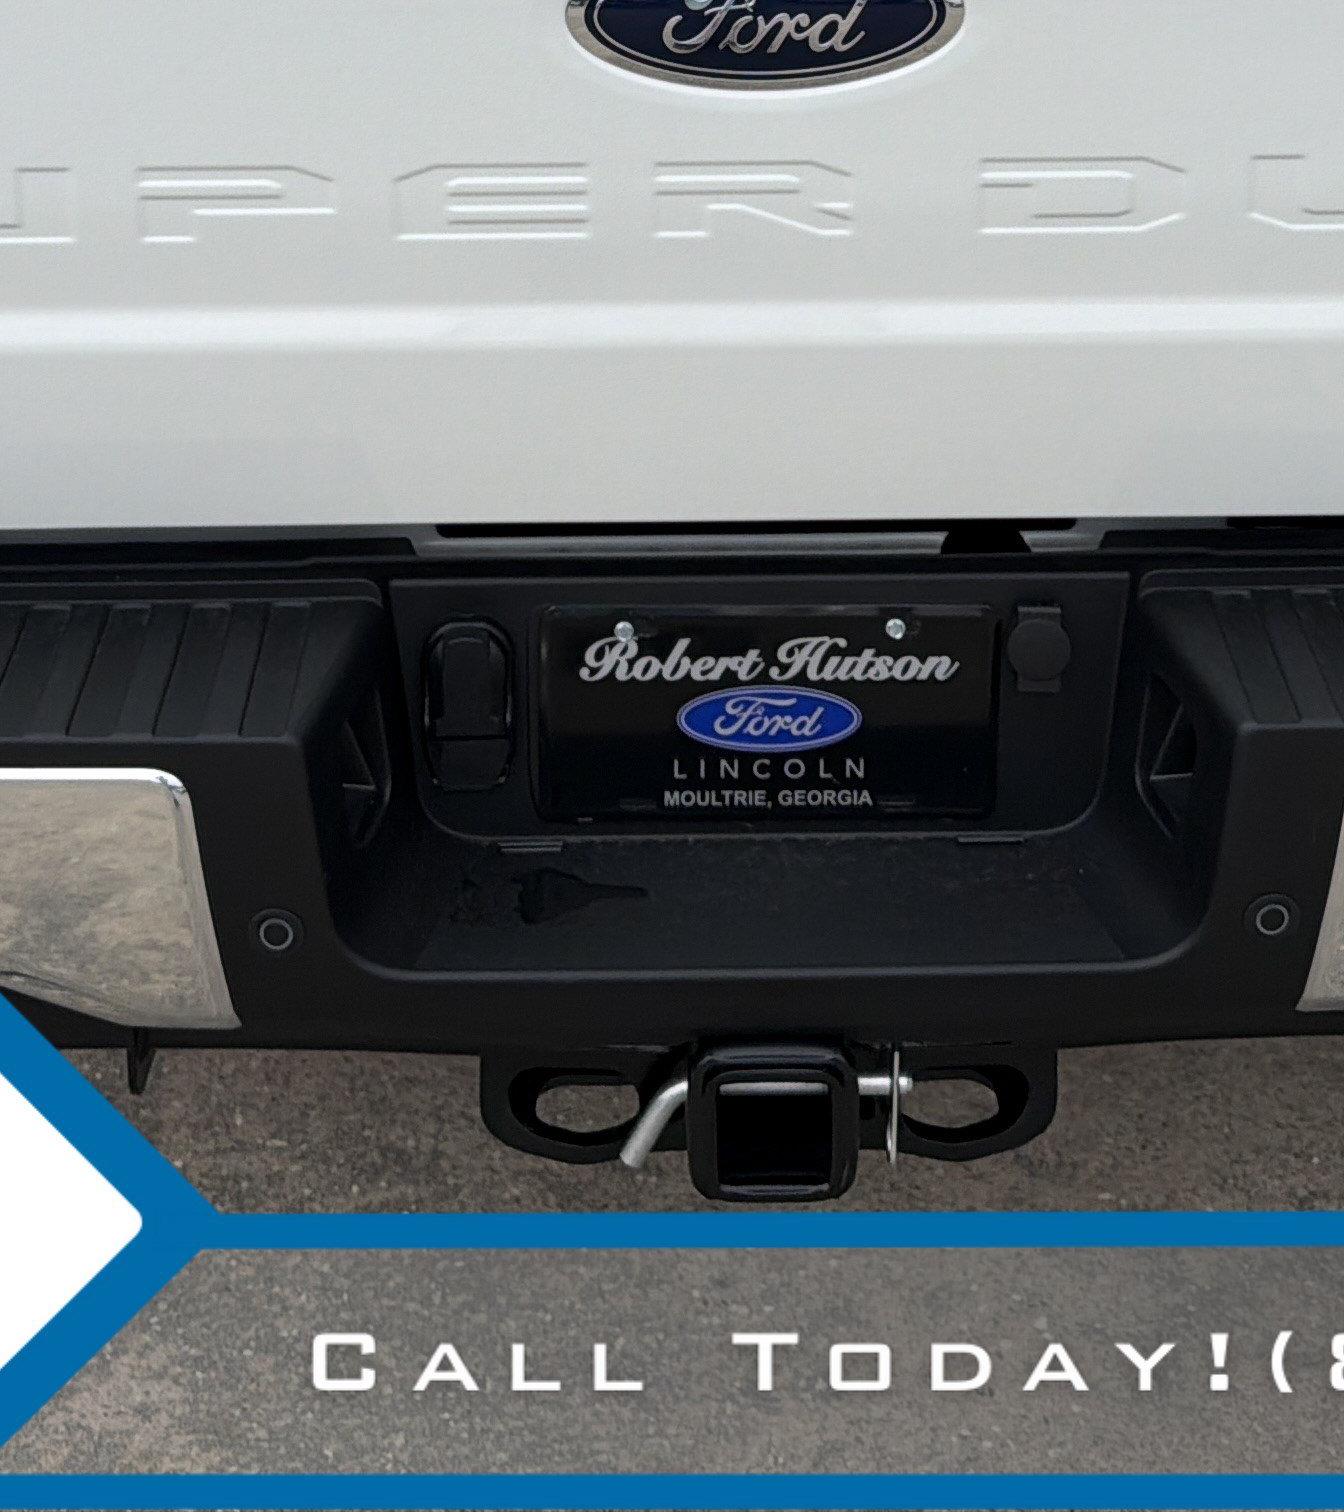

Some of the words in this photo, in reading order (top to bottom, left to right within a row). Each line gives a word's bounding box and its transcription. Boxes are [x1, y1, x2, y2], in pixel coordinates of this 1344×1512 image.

[579, 636, 765, 683] Robert
[769, 635, 960, 683] Hutson
[713, 696, 825, 737] Ford
[674, 758, 865, 780] LINCOLN
[664, 790, 773, 809] MOULTRIE,
[777, 790, 874, 808] GEORGIA
